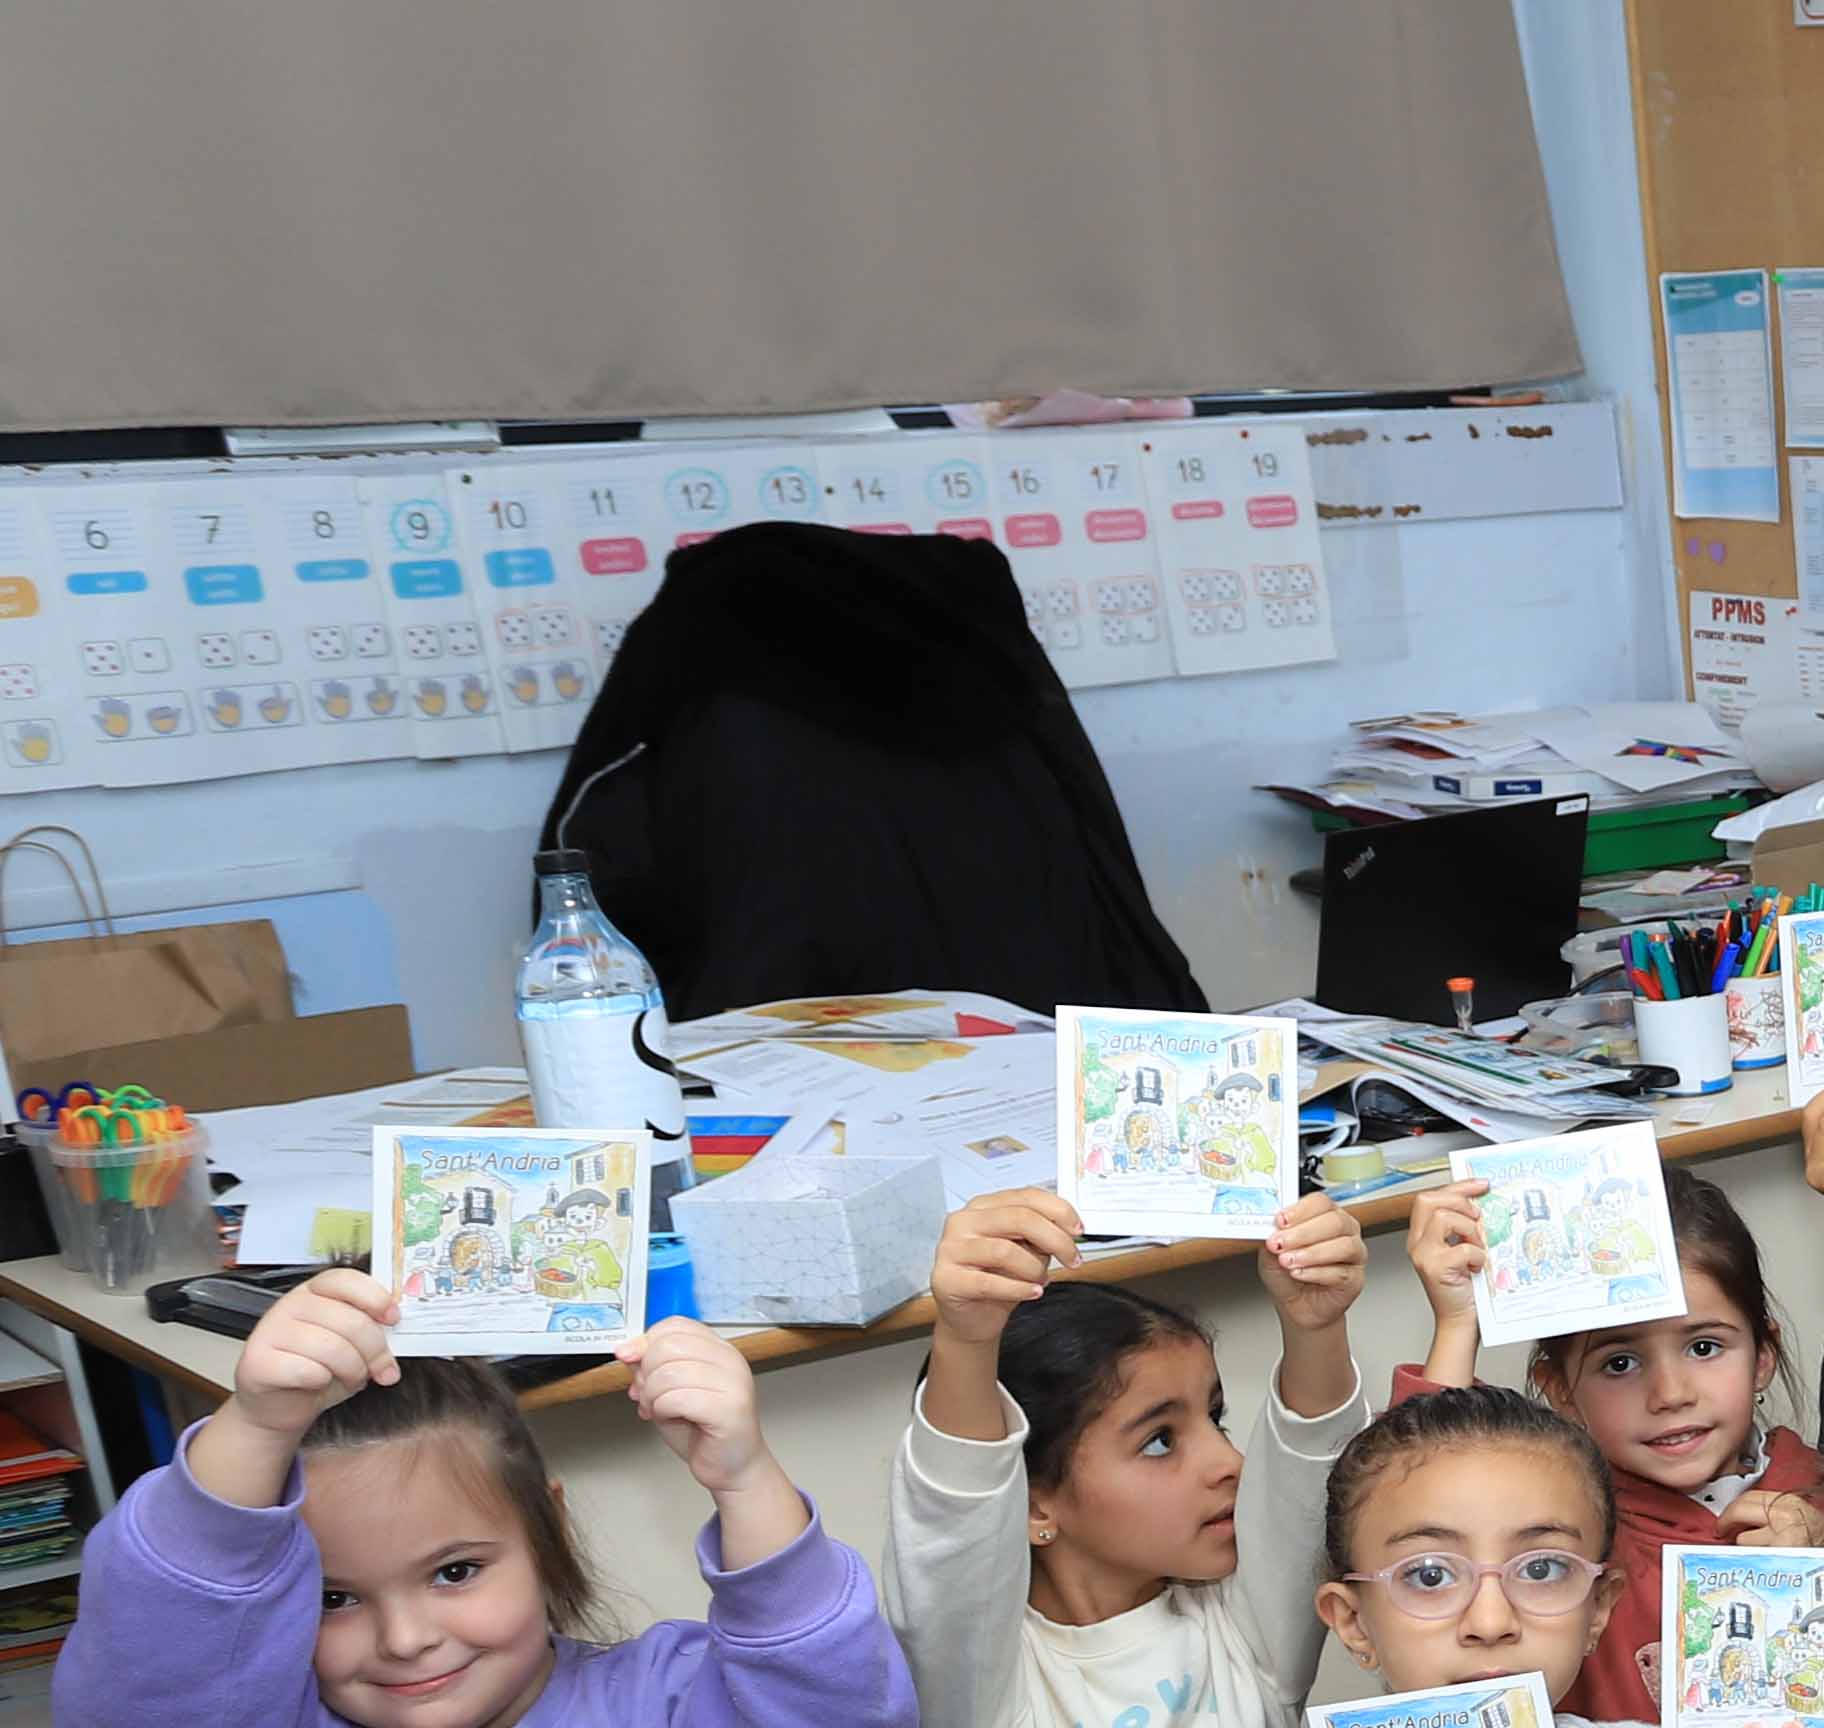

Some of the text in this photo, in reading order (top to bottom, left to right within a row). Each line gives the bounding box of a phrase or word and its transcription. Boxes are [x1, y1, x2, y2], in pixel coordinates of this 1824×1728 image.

[84, 452, 1279, 551] 6 7 8 9 10 11 12 13 14 15 16 17 18 19
[1711, 597, 1766, 626] PPMS
